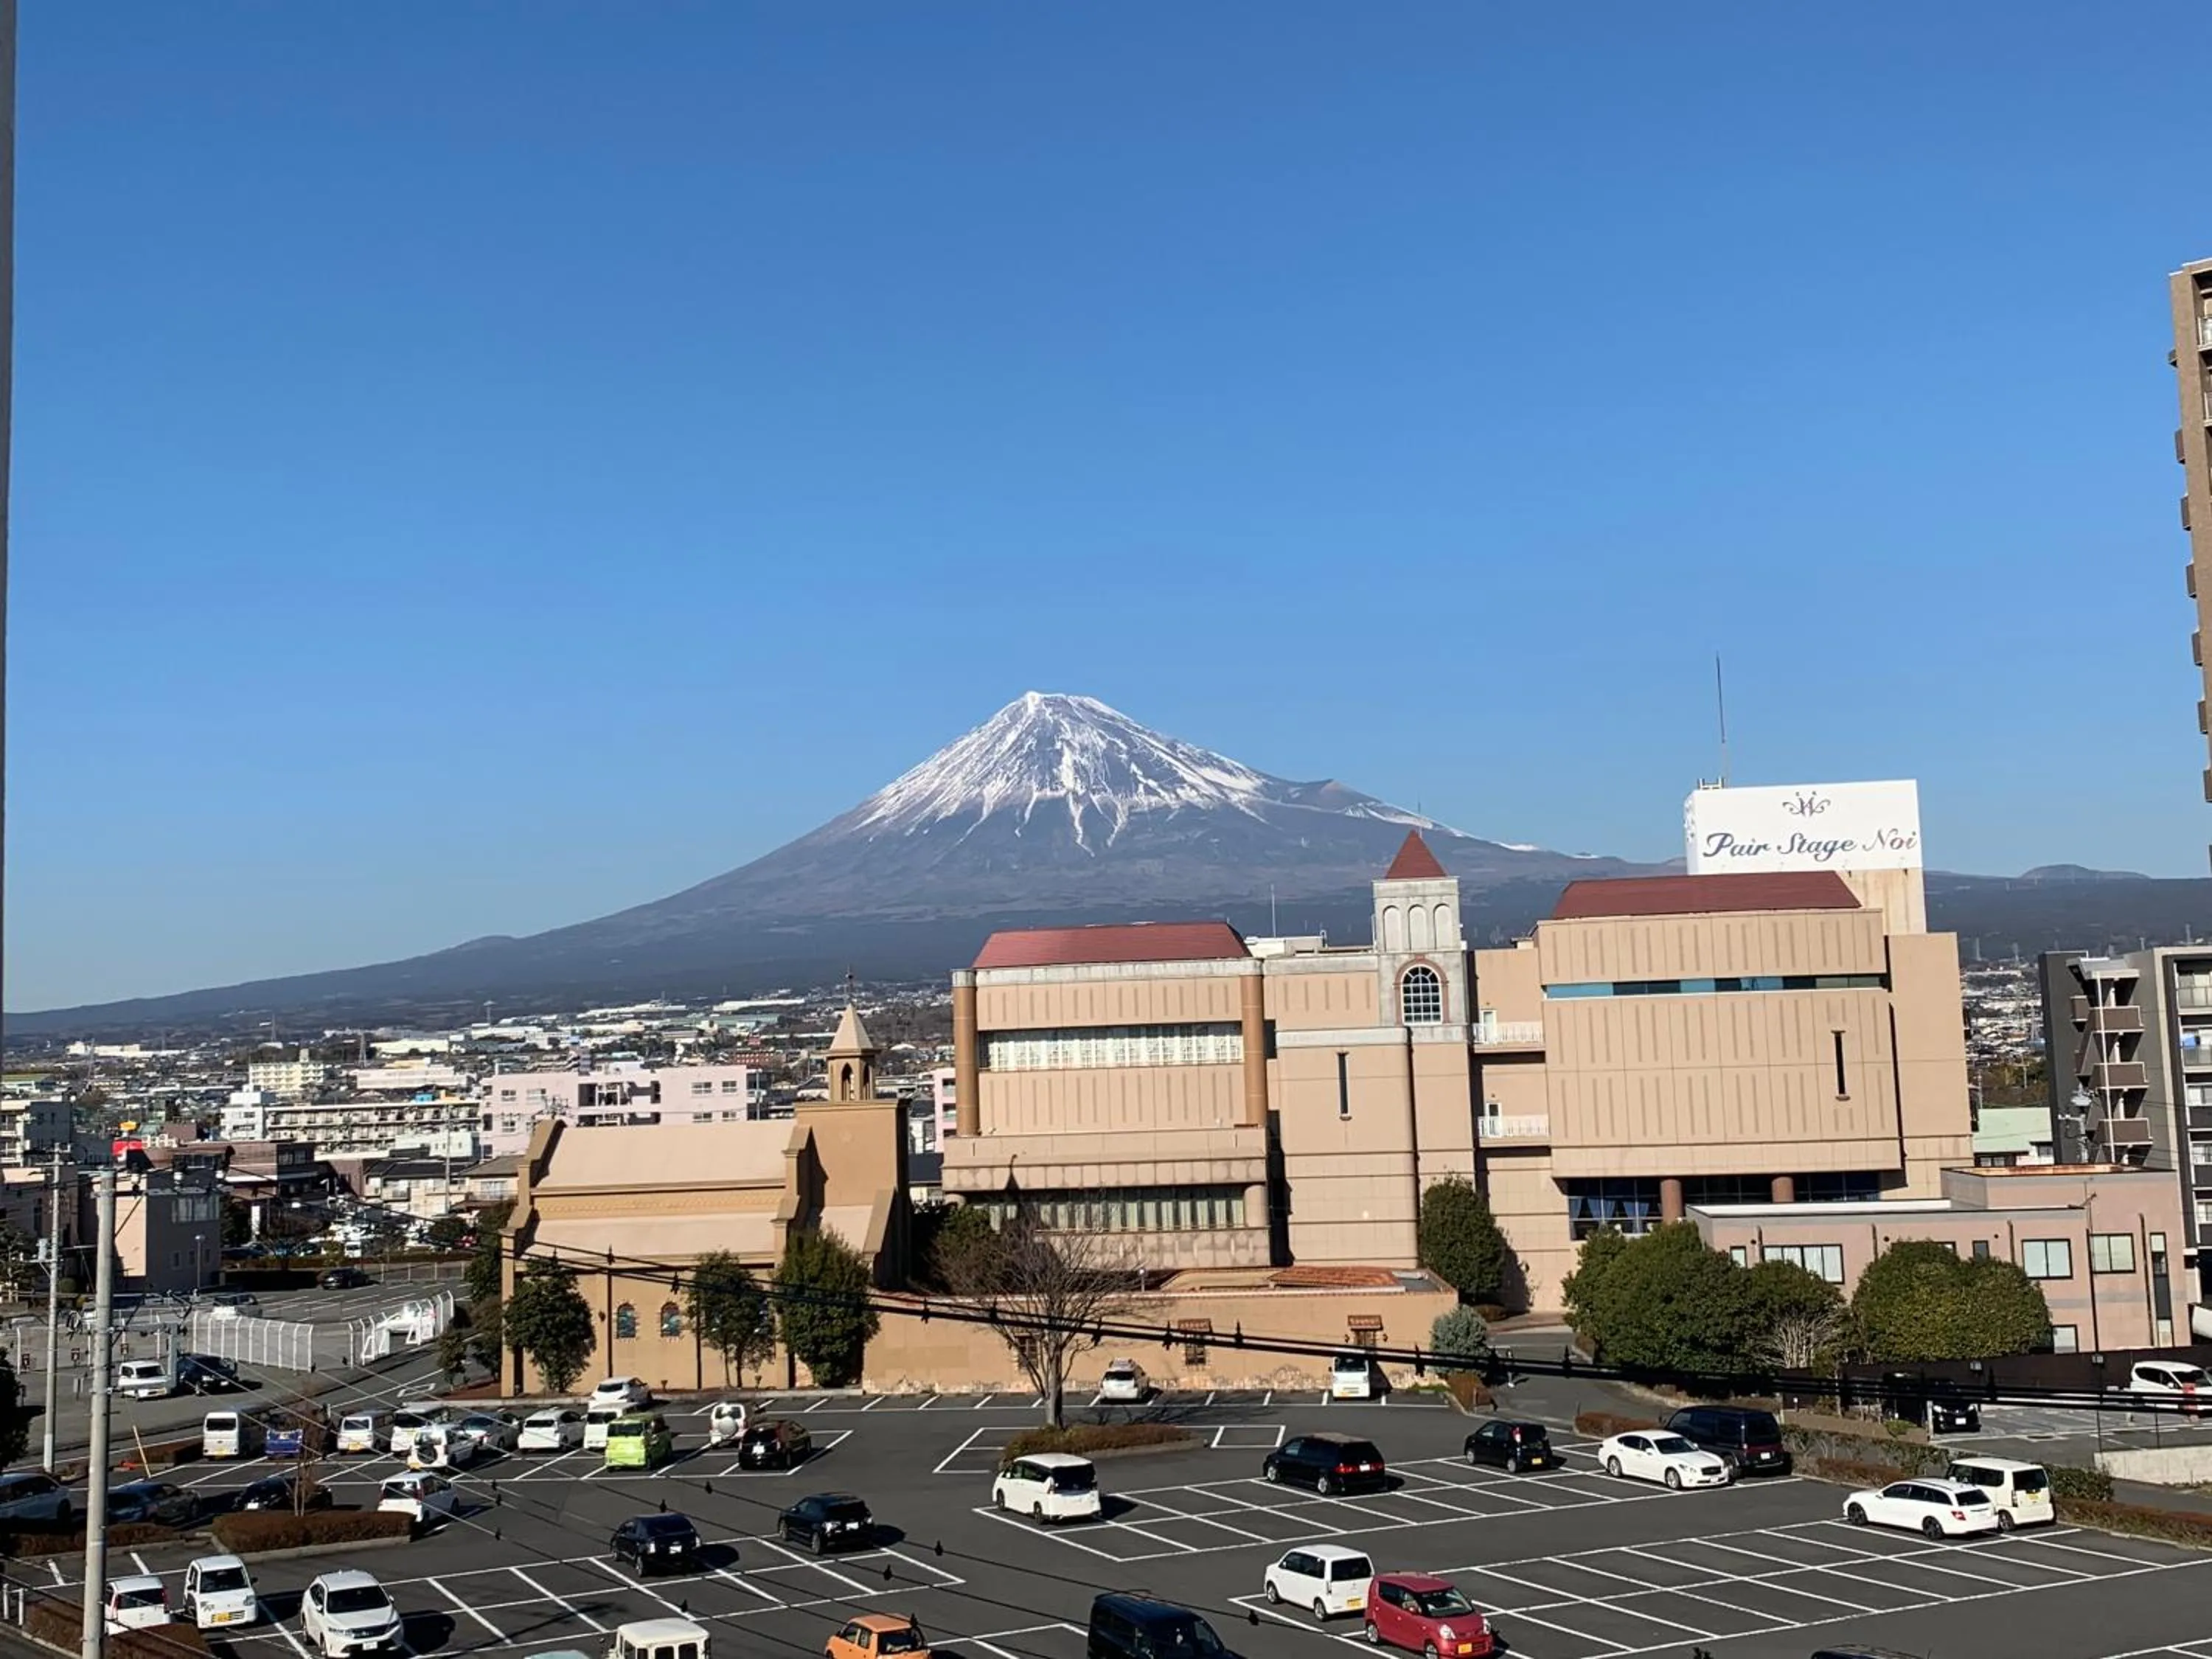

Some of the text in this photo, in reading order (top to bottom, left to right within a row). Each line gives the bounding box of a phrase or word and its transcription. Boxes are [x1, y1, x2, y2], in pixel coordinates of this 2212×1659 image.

[1703, 828, 1917, 862] Pair Stage Noi
